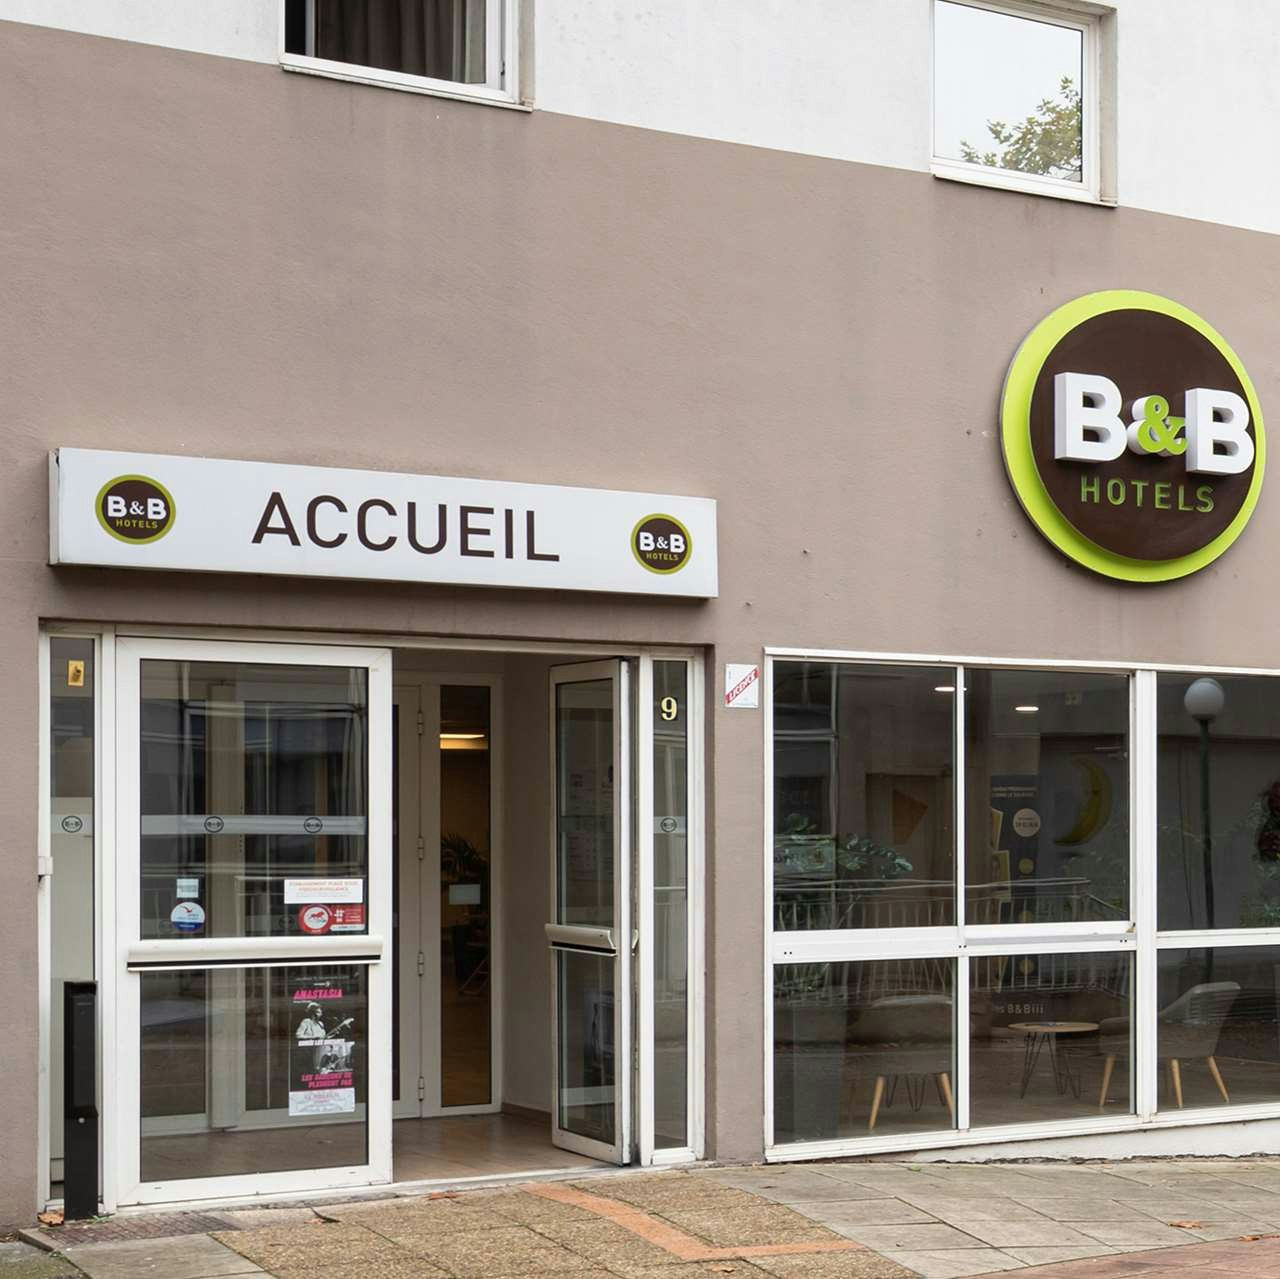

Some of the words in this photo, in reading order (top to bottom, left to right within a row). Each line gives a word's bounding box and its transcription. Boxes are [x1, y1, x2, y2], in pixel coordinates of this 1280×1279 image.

[1054, 372, 1255, 474] B&B
[1081, 475, 1215, 513] HOTELS
[107, 496, 167, 520] B&B
[115, 519, 159, 529] HOTELS
[251, 492, 560, 562] ACCUEIL
[640, 532, 685, 553] B&B
[646, 553, 679, 561] HOTELS
[661, 696, 678, 721] 9
